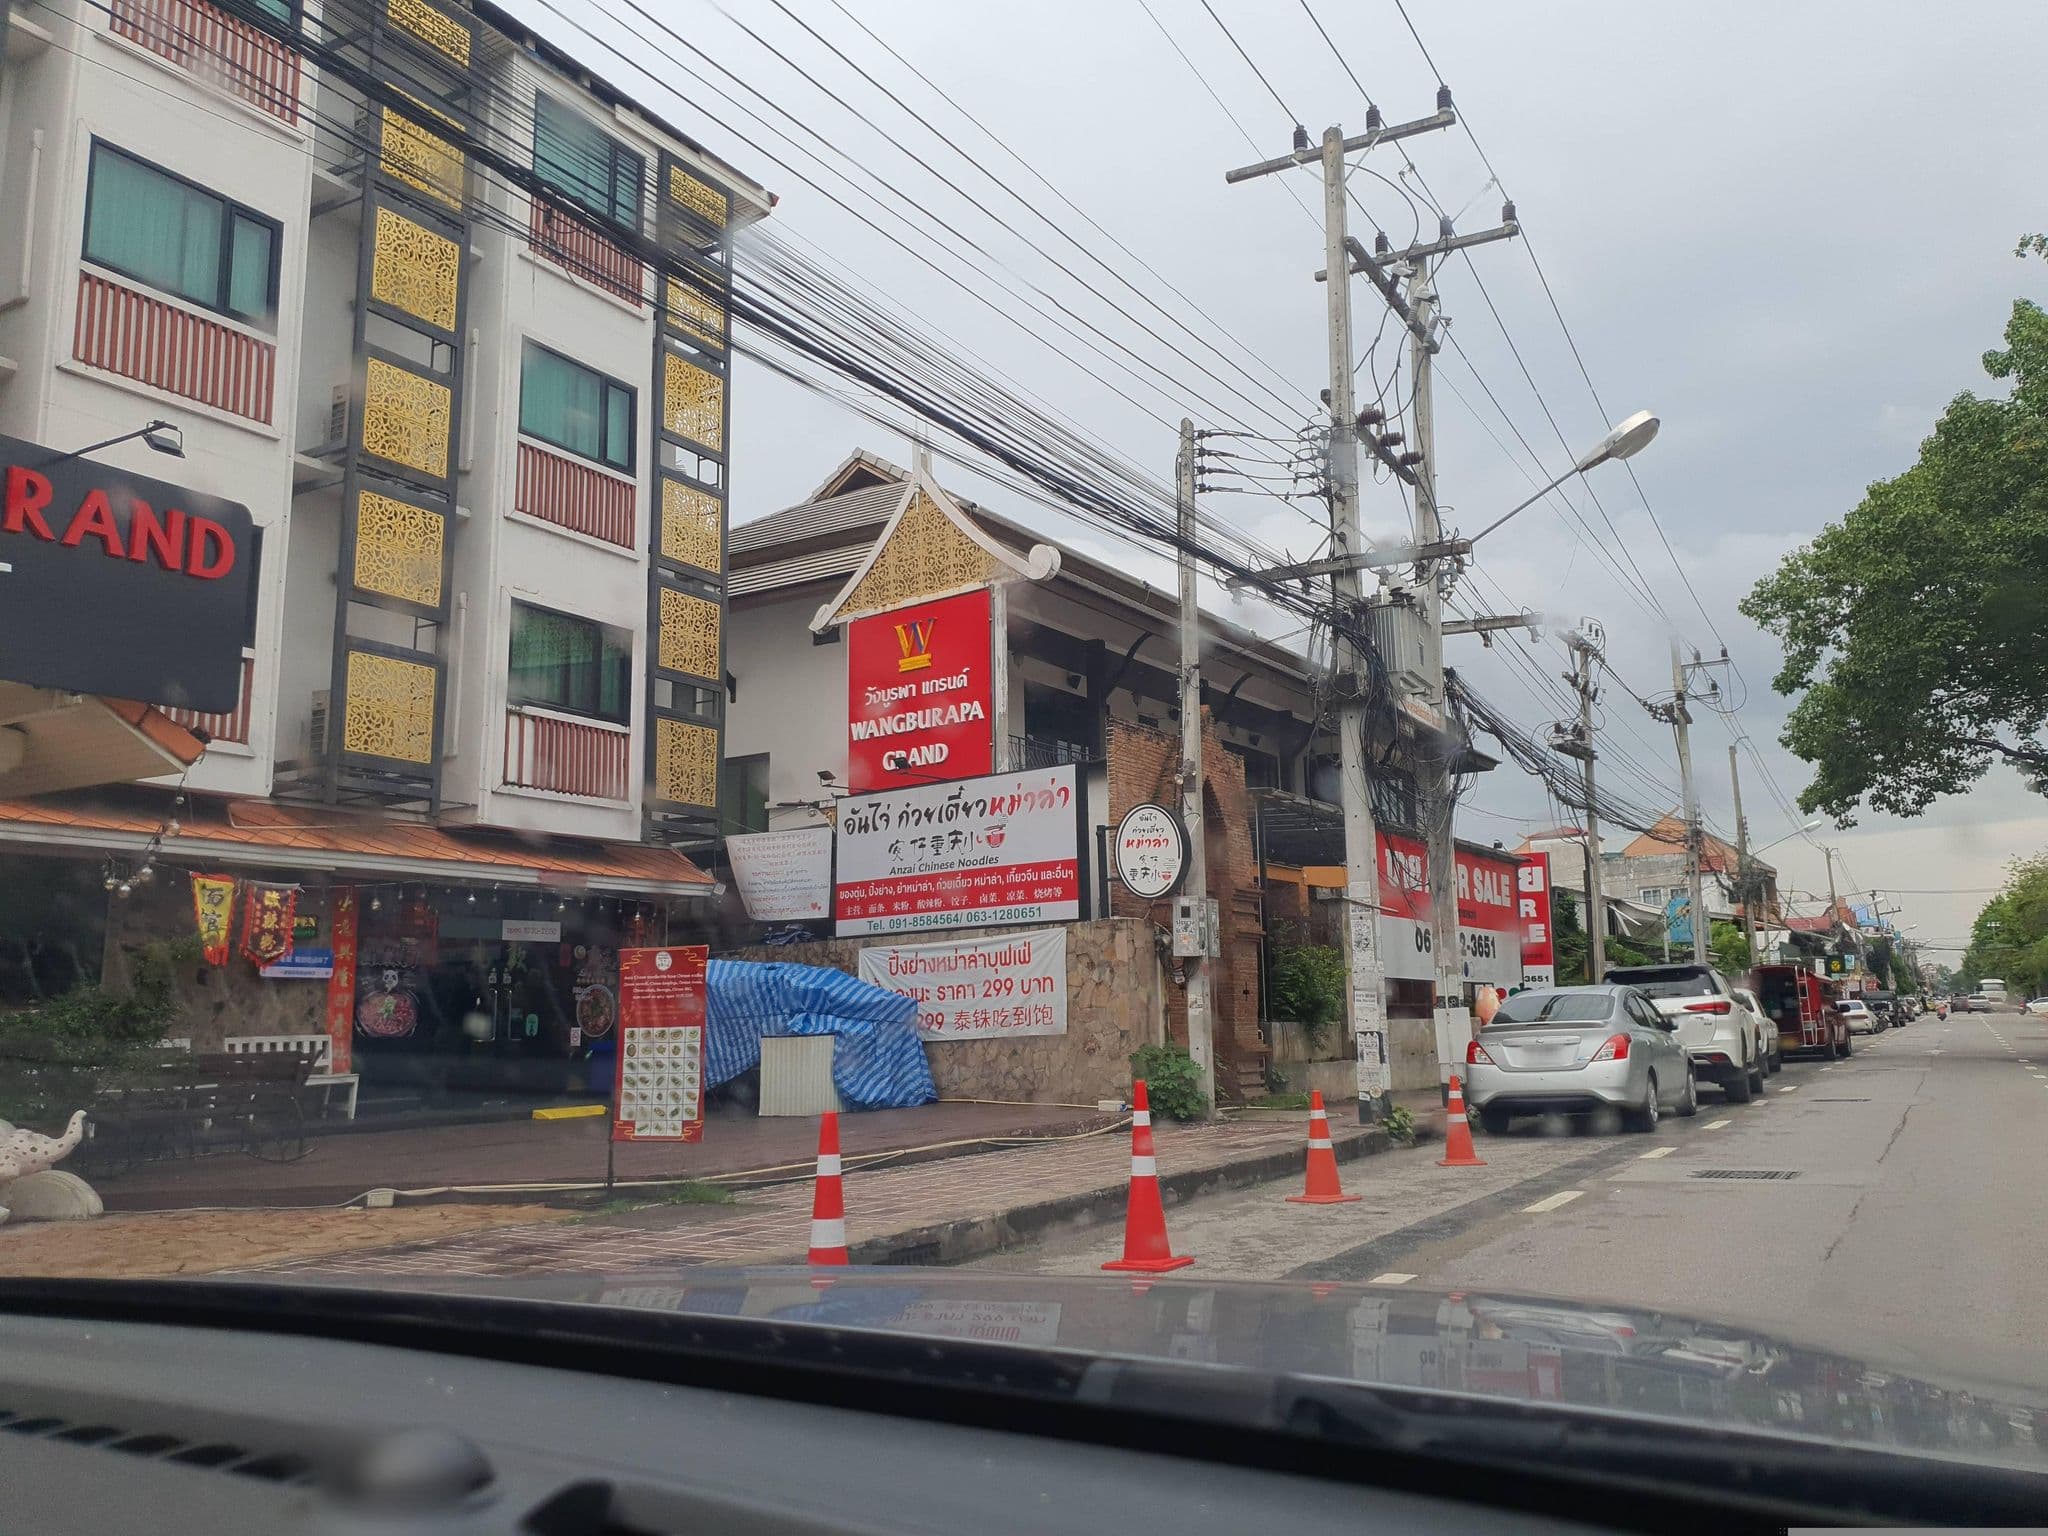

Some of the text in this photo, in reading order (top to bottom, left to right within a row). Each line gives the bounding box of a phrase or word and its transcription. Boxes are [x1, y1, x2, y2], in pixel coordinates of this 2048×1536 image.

[3, 464, 236, 580] RAND
[865, 668, 970, 707] วังบูรพา แกรนด์
[851, 700, 984, 741] WANGBURAPA
[844, 803, 890, 835] อันไจ่
[1126, 834, 1169, 849] หม่าล่า
[889, 855, 999, 876] Anzai Chinese Noodles
[1473, 867, 1511, 907] SALE
[867, 920, 885, 931] Tel.
[967, 907, 1041, 922] 063-1280651
[937, 983, 975, 1001] ราคา
[983, 978, 1013, 998] 299
[1021, 976, 1054, 995] บาท
[954, 1003, 1054, 1031] 泰铢吃到饱
